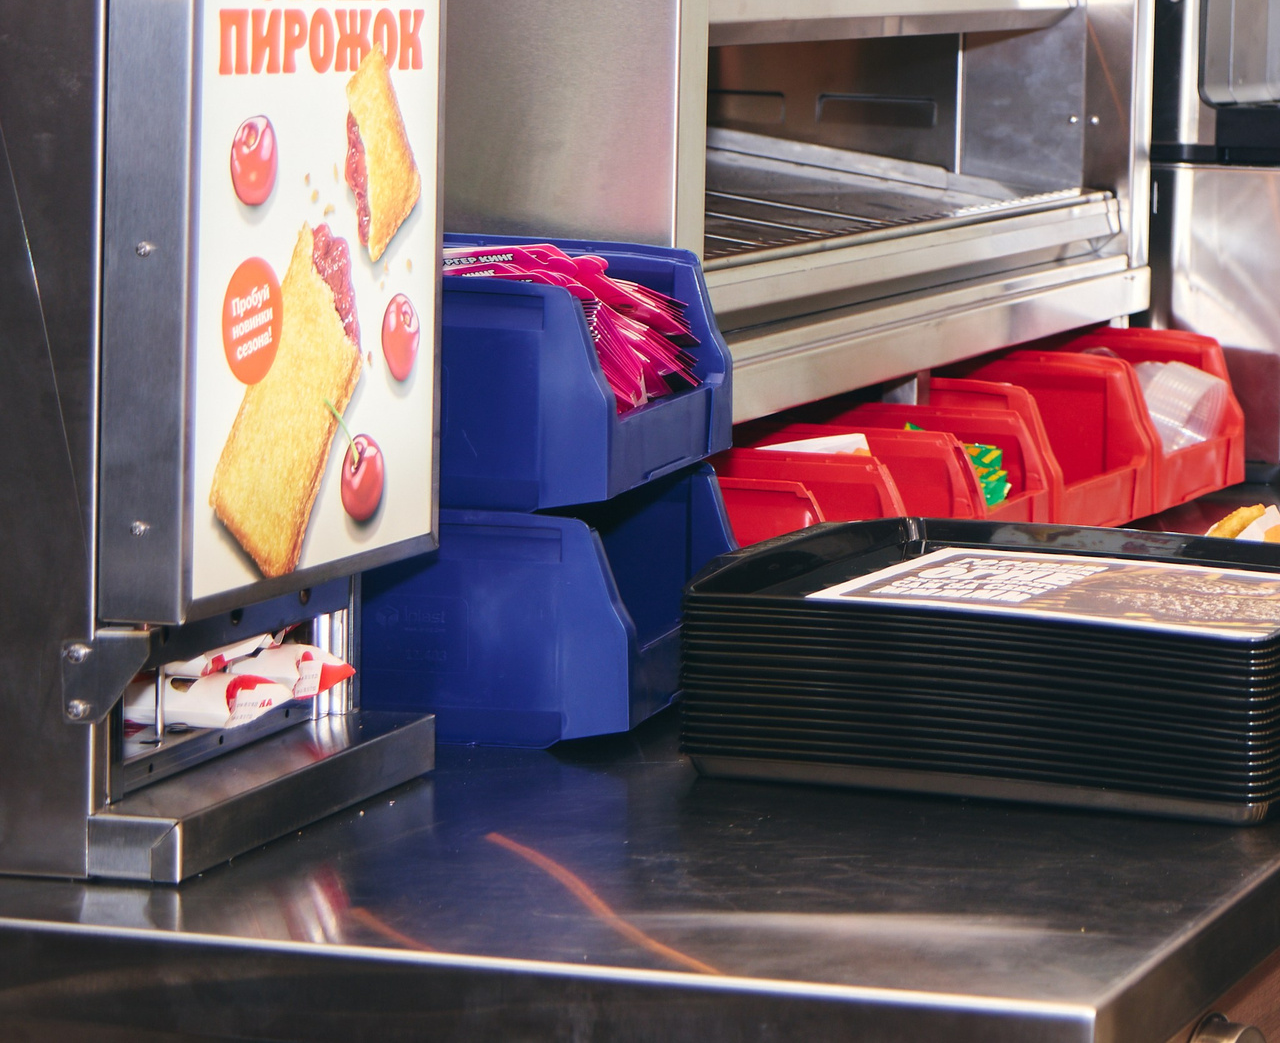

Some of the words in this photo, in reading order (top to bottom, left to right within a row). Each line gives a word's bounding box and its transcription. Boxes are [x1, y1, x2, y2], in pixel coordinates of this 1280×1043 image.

[218, 6, 425, 76] ПИРОЖОК
[443, 257, 477, 266] РГЕР
[478, 253, 514, 263] КИНГ
[231, 283, 270, 318] Пробуй
[232, 307, 273, 340] новинки
[236, 325, 273, 361] сезона!
[917, 566, 1086, 586] ОГНЕ
